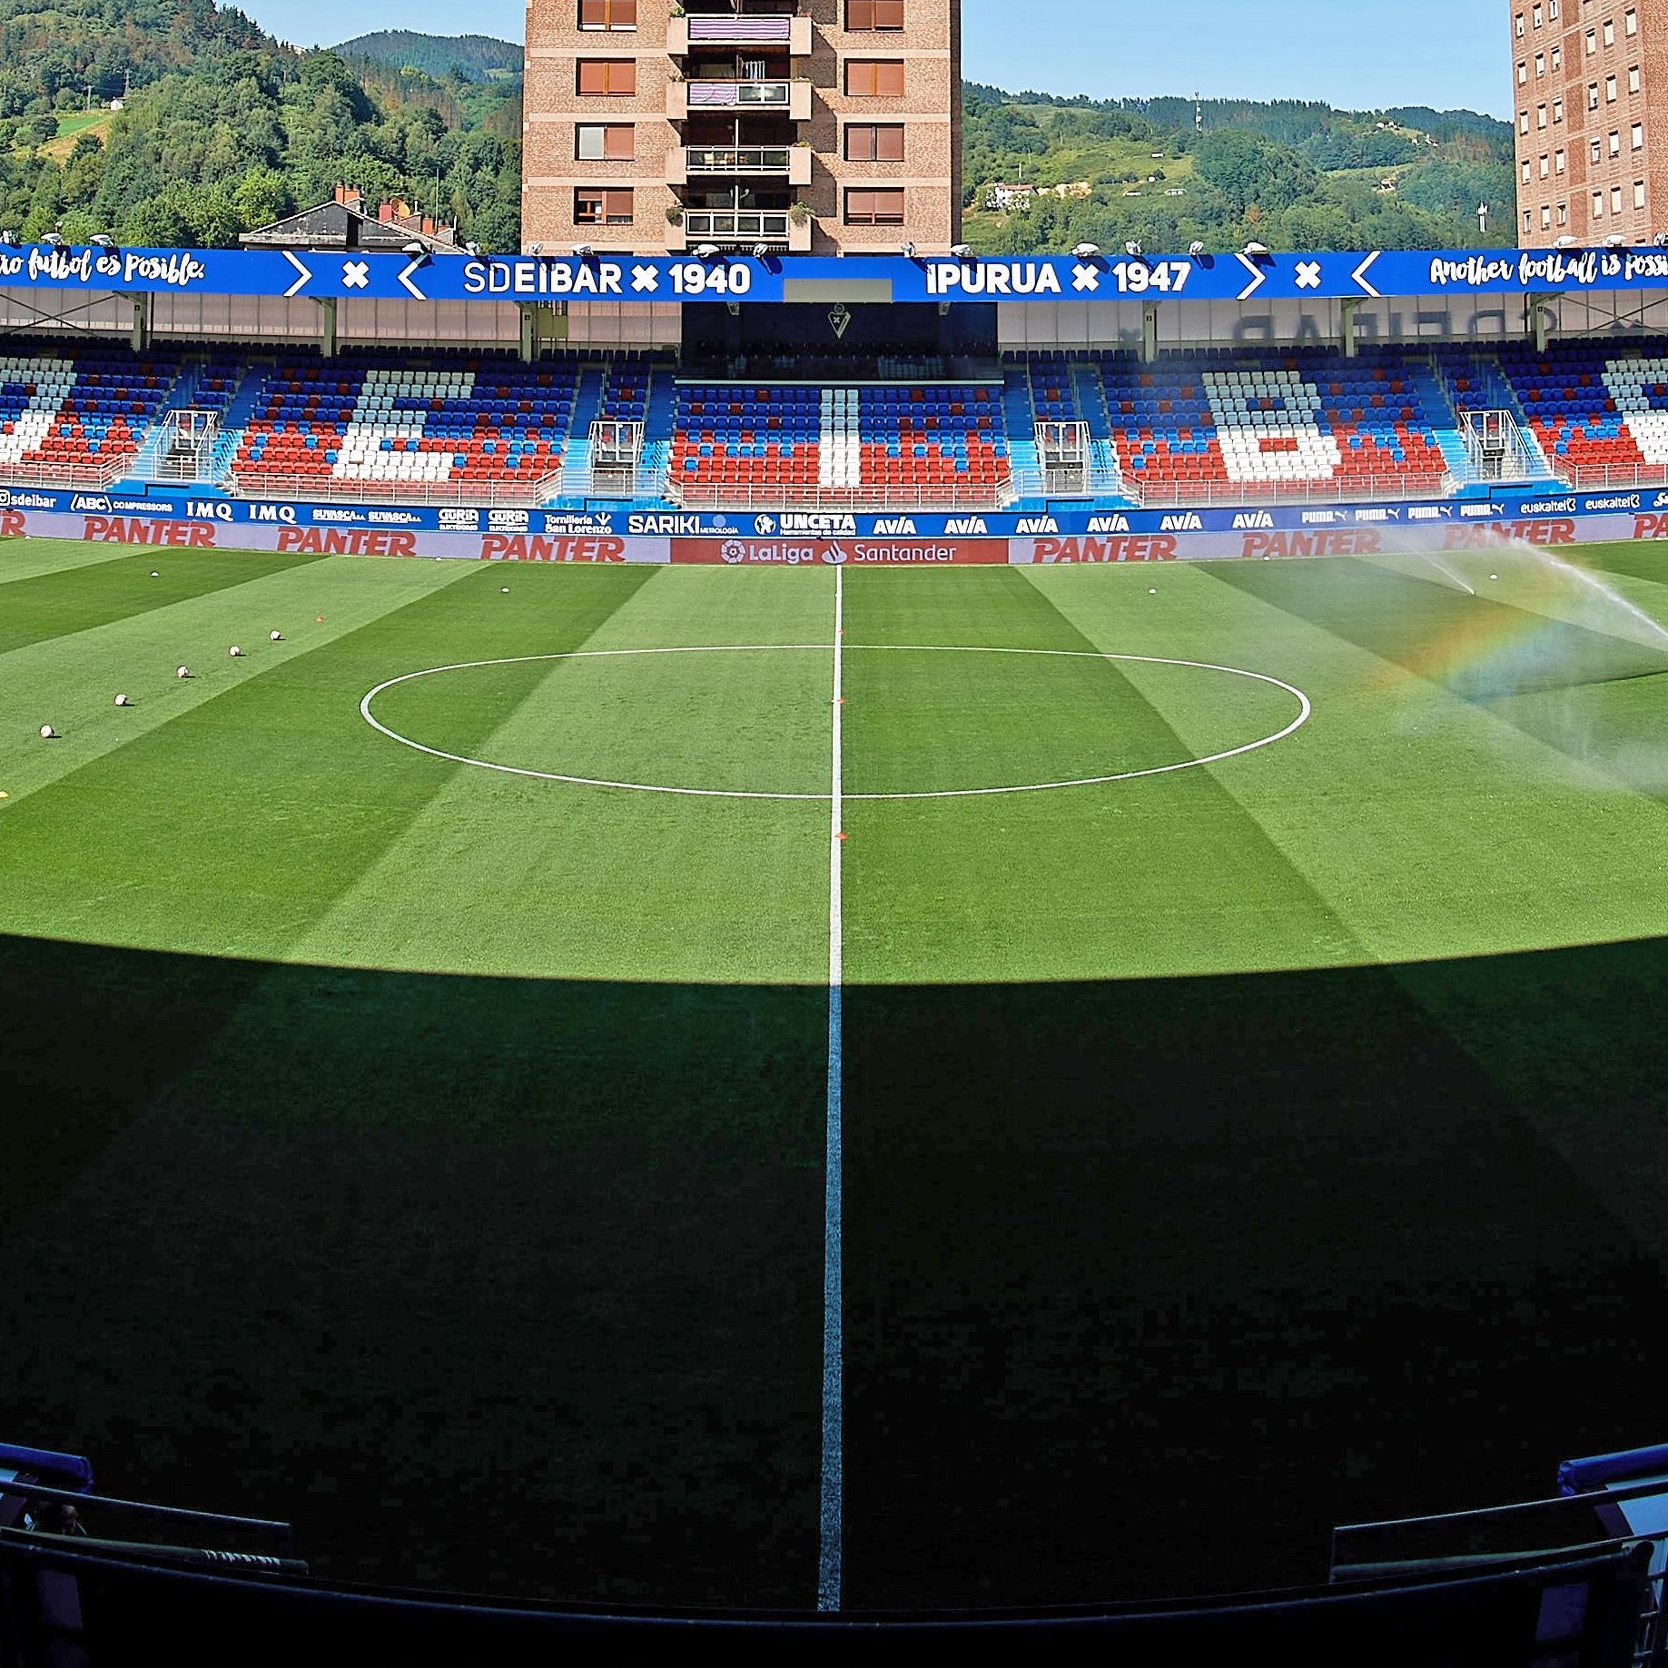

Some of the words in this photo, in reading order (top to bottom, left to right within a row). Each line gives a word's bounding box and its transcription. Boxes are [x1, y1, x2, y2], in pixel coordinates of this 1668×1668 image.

[96, 256, 121, 278] es
[668, 263, 751, 294] 1940
[926, 262, 1062, 294] IPURUA
[1112, 261, 1191, 292] 1947
[1430, 255, 1513, 285] Another
[1518, 252, 1598, 284] football
[1601, 254, 1622, 277] is
[10, 493, 57, 508] sdeibar
[186, 501, 233, 522] IMQ
[249, 504, 296, 524] IMQ
[1301, 510, 1335, 523] PUMA
[1355, 508, 1388, 521] PUMA
[1408, 506, 1440, 519] PUMA
[1460, 504, 1493, 517] PUMA
[1520, 499, 1567, 514] euskaltel
[1585, 496, 1631, 510] euskaltel
[83, 516, 217, 547] PANTER
[628, 515, 699, 535] SARIKI
[780, 514, 856, 529] UNCETA
[1441, 518, 1576, 551] PANTER
[276, 526, 417, 557] PANTER
[481, 534, 626, 563] PANTER
[749, 543, 814, 564] LaLiga
[854, 543, 957, 561] Santander
[1032, 535, 1178, 563] PANTER
[1241, 528, 1382, 557] PANTER
